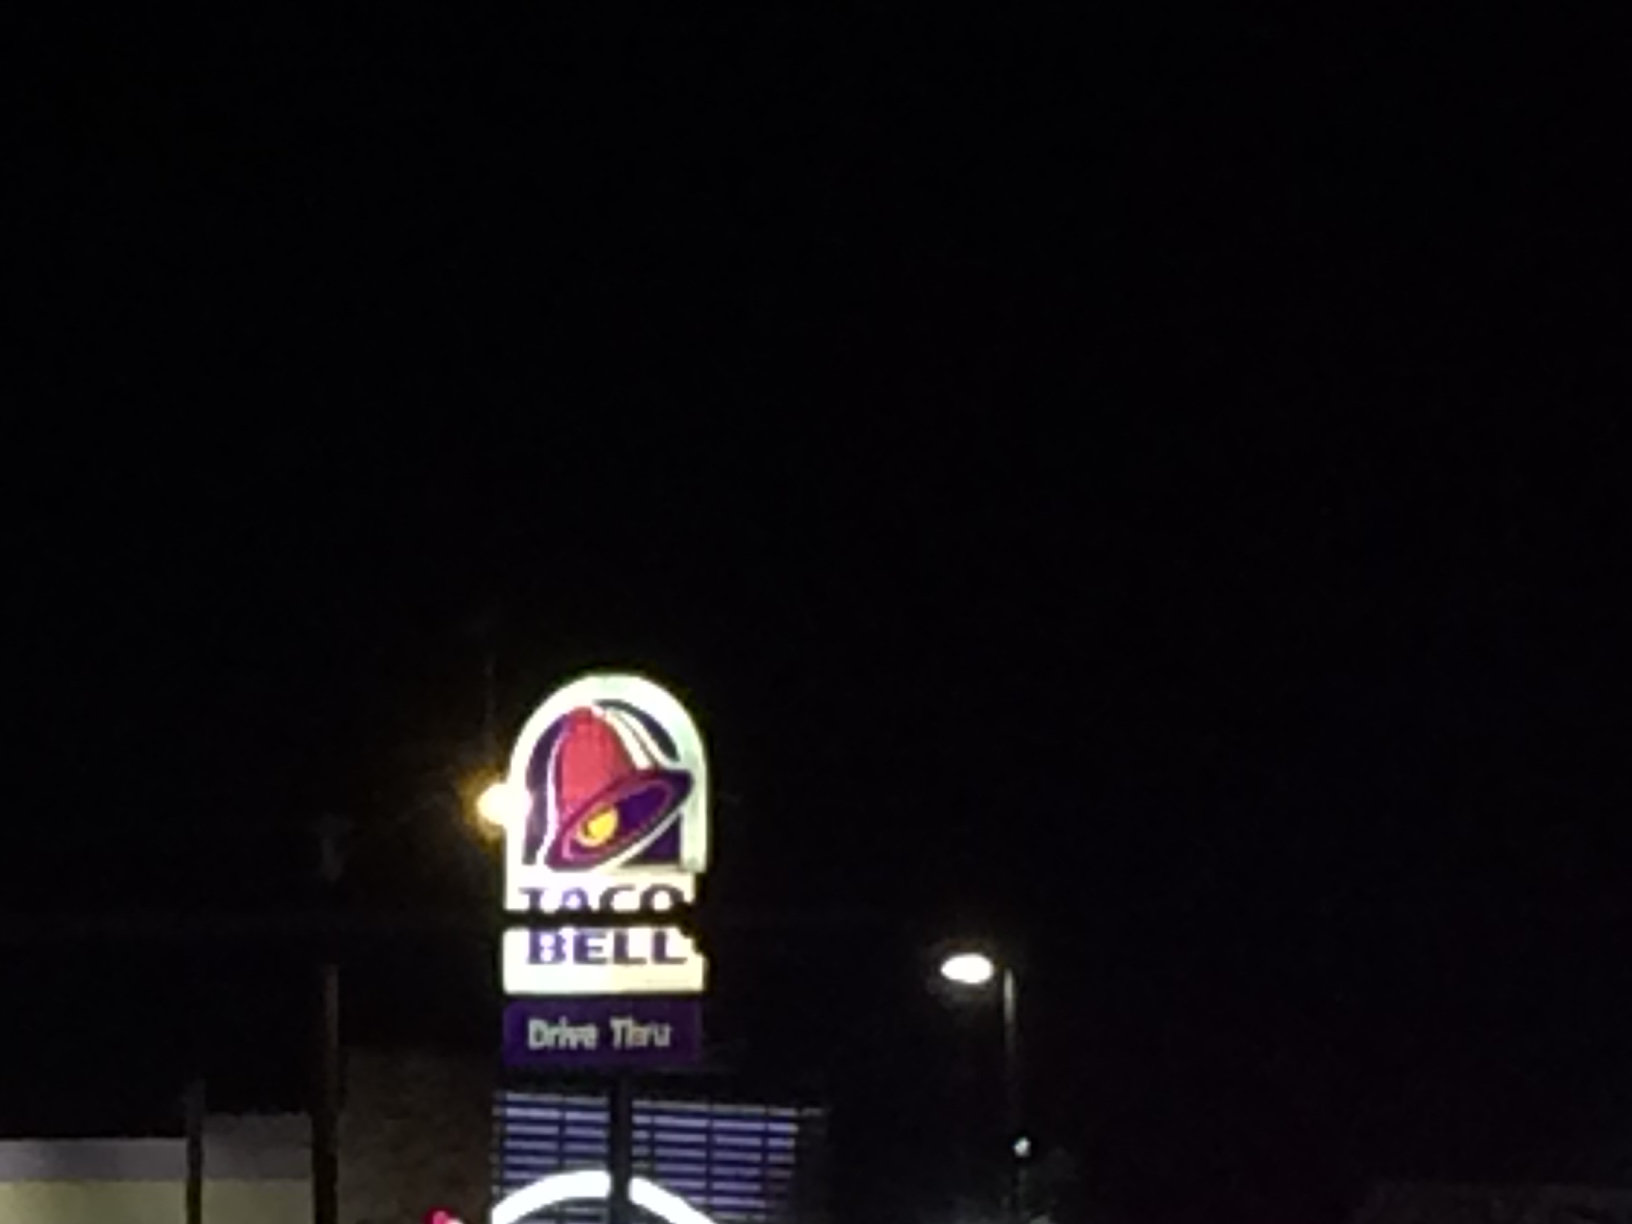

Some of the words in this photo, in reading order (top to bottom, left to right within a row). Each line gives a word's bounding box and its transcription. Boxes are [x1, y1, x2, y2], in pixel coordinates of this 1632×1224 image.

[518, 883, 686, 915] TACO
[526, 928, 688, 965] BELL
[527, 1017, 597, 1050] Drive
[609, 1018, 672, 1048] Thru
